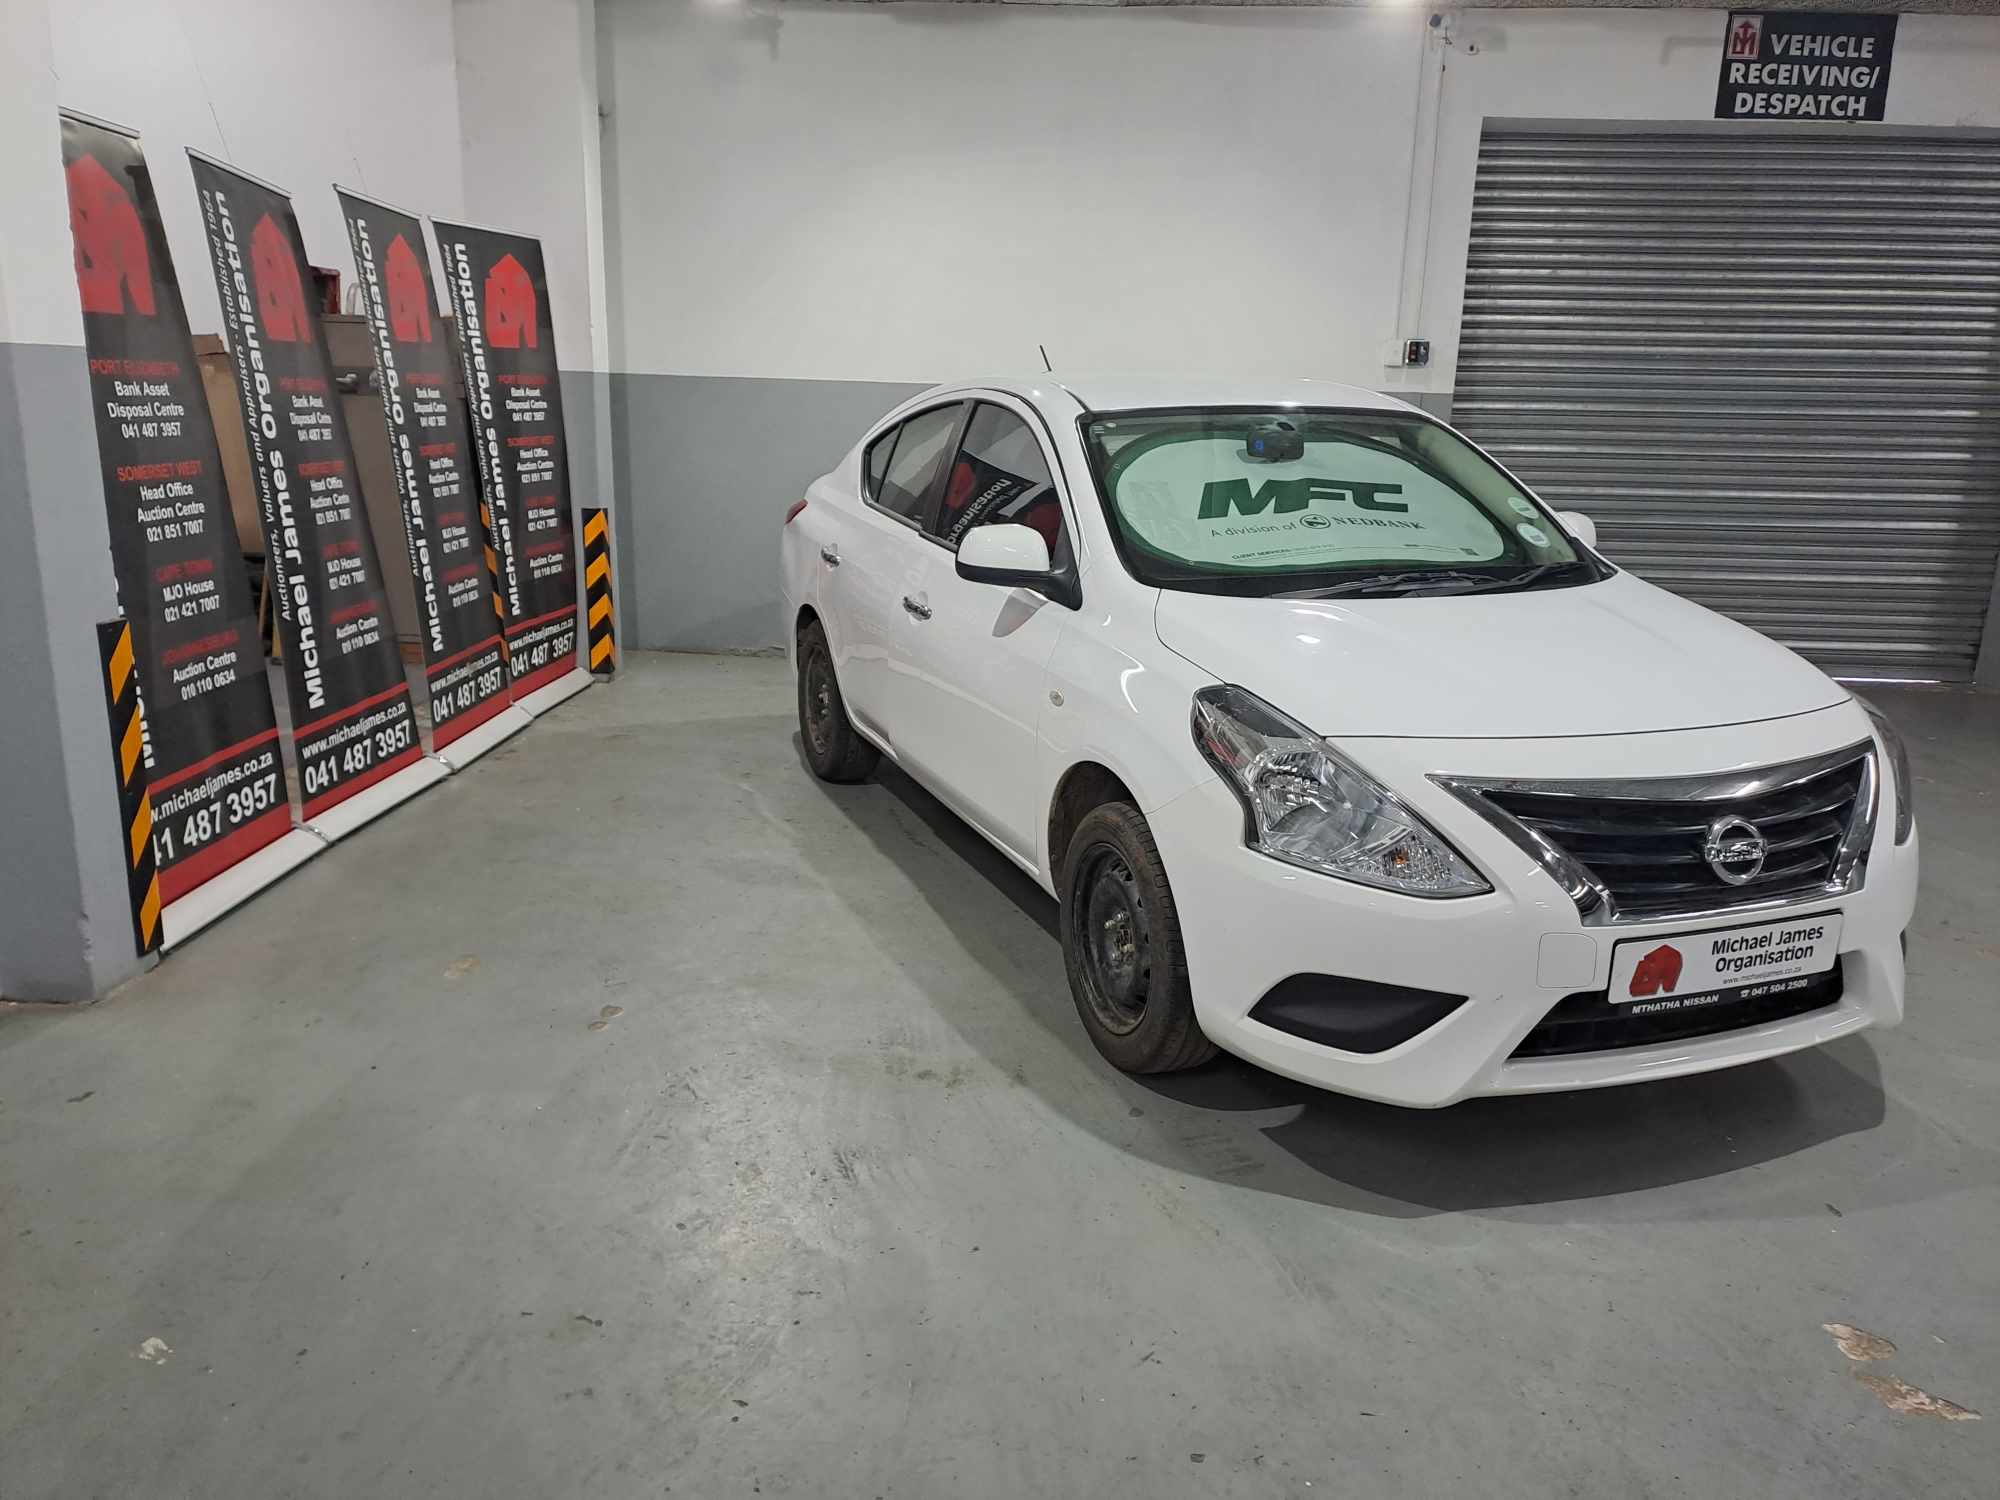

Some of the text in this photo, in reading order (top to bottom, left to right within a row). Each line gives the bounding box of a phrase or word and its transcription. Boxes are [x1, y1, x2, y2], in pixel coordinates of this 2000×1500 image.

[1770, 34, 1876, 58] VEHICLE
[1728, 63, 1881, 89] RECEIVING/
[1734, 93, 1868, 118] DESPATCH
[202, 190, 218, 231] 1964
[212, 235, 239, 329] Established
[114, 381, 171, 397] Bank Asset
[236, 343, 258, 428] Appraisers
[107, 402, 185, 421] Disposal Centre
[121, 422, 182, 439] 041 487 3957
[250, 431, 265, 462] and
[399, 434, 425, 531] James
[486, 427, 507, 511] James
[139, 482, 194, 501] Head Office
[257, 466, 276, 523] Valuers
[270, 449, 303, 565] James
[1197, 477, 1409, 520] MFC
[137, 501, 205, 523] Auction Centre
[1211, 516, 1427, 537] A division of NEDBANK
[146, 519, 204, 541] 021 851 7007
[498, 518, 521, 616] Michael
[184, 579, 215, 596] House
[416, 538, 444, 652] Michael
[164, 595, 221, 623] 021 421 7007
[289, 575, 326, 710] Michael
[511, 631, 574, 677] 041 487 3957
[173, 651, 237, 684] Auction Centre
[181, 668, 236, 701] 010 110 0634
[433, 666, 501, 723] 041 487 3957
[305, 719, 411, 794] 041 487 3957
[183, 802, 222, 847] 487
[226, 773, 277, 824] 3957
[1711, 926, 1824, 956] Michael James
[1715, 945, 1814, 973] Organisation
[1631, 994, 1720, 1015] MTHATHA NISSAN
